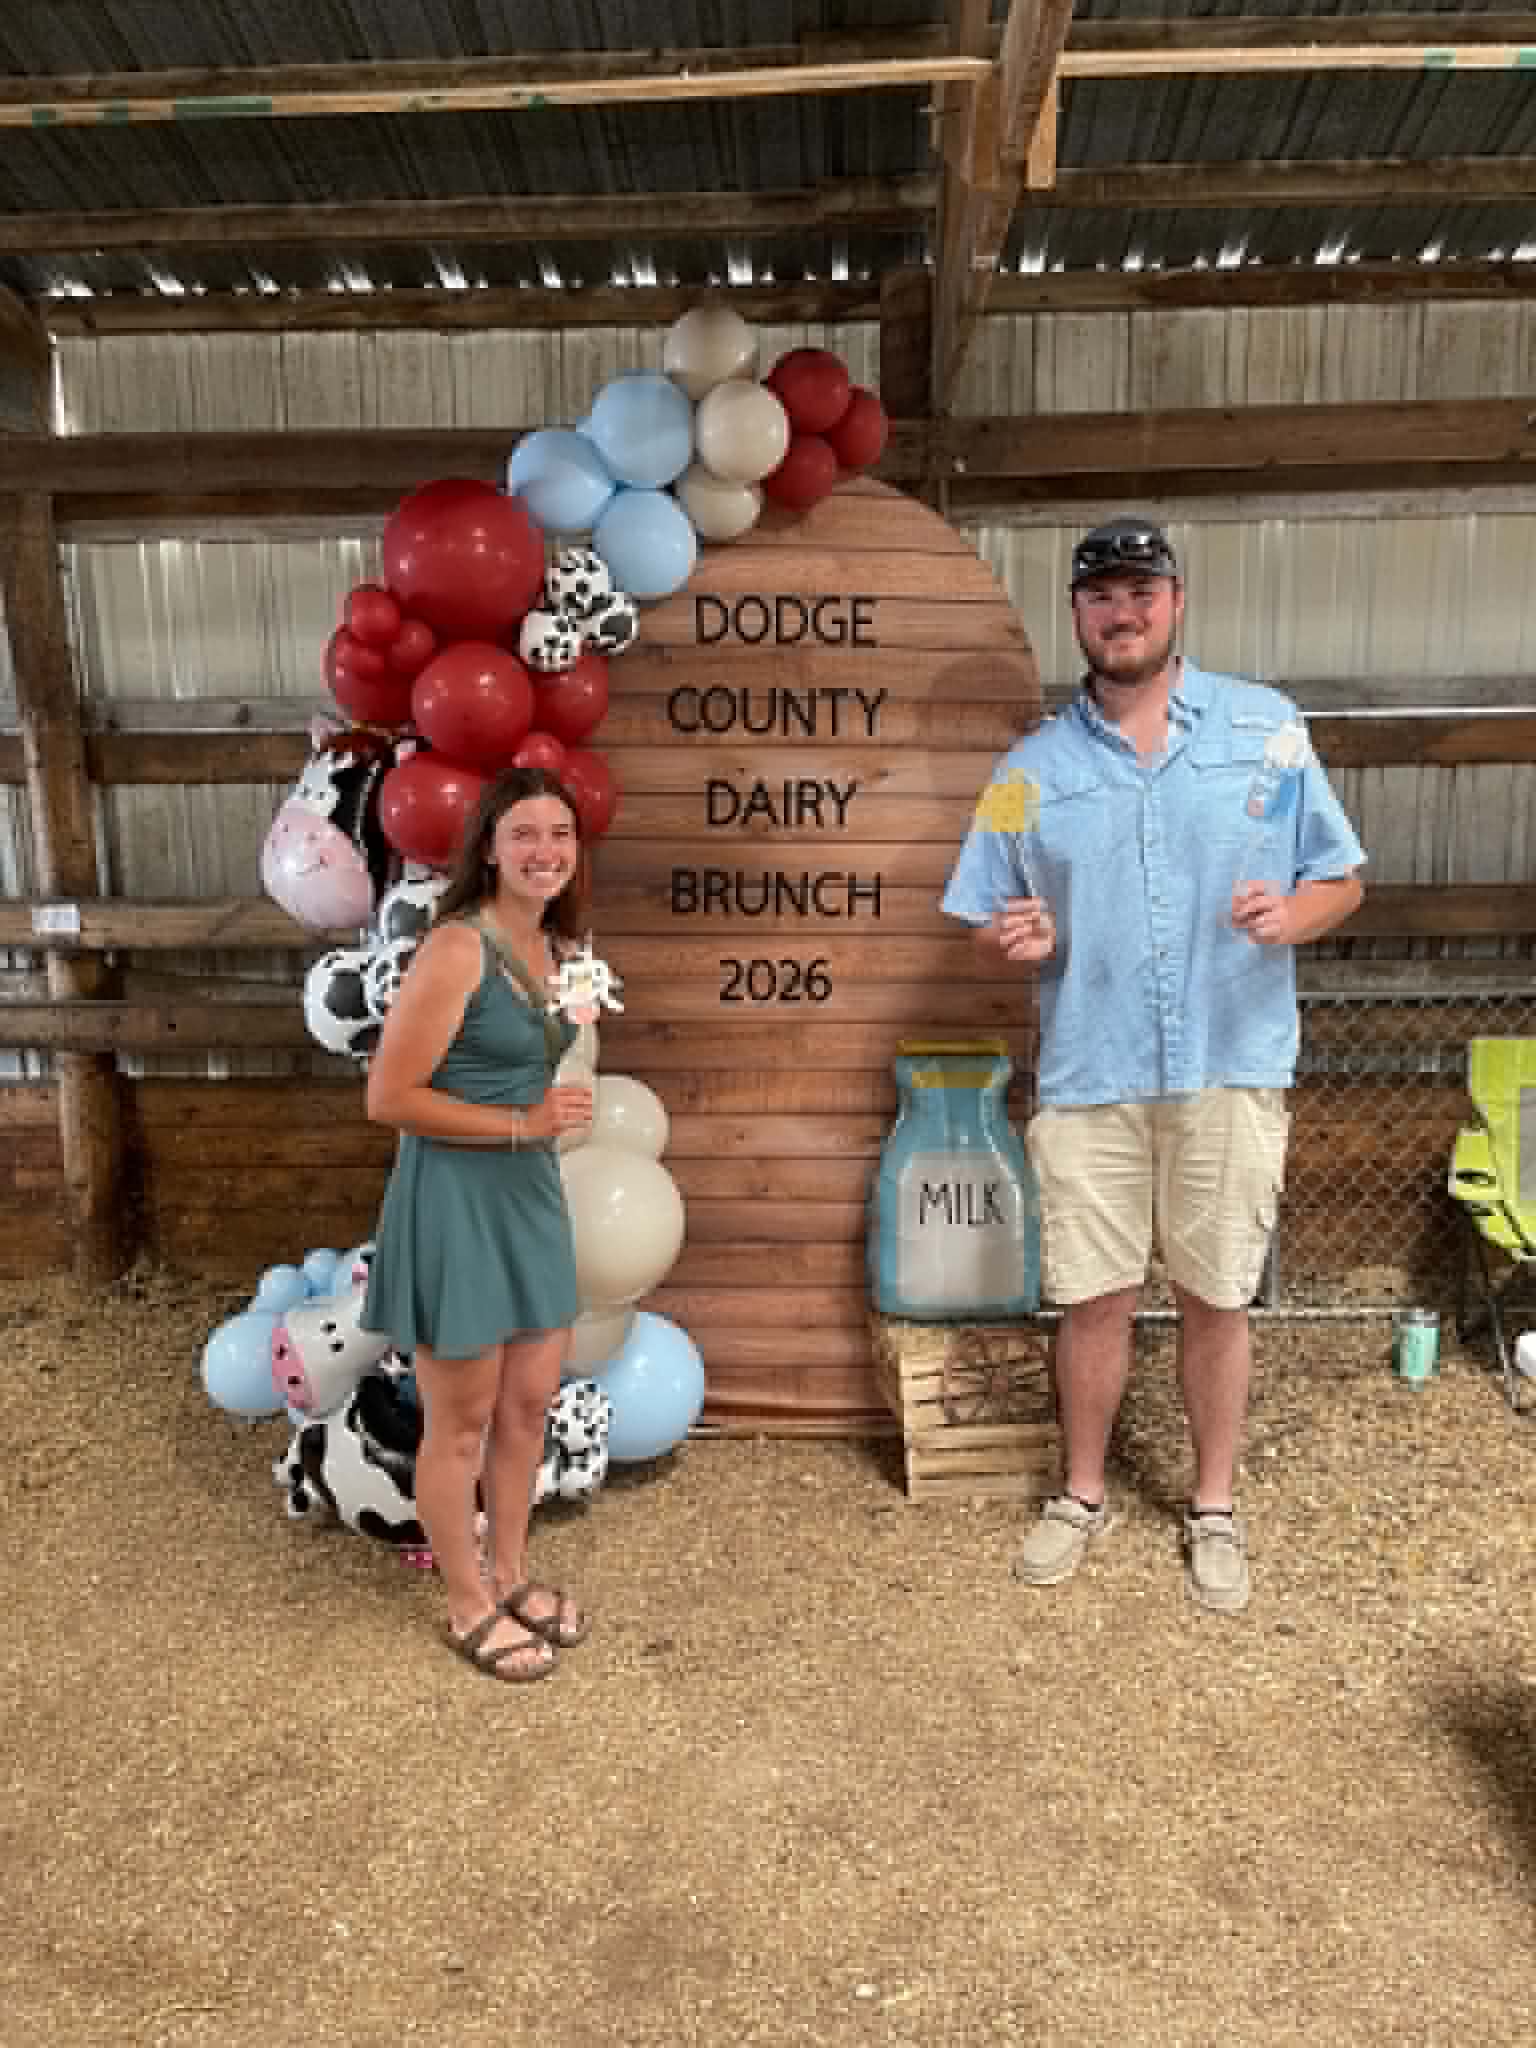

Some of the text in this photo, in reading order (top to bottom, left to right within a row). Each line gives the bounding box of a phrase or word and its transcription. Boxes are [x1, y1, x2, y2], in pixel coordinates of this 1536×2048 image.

[694, 595, 879, 646] DODGE
[667, 686, 887, 735] COUNTY
[705, 779, 858, 828] DAIRY
[671, 869, 881, 918] BRUNCH
[719, 959, 833, 1002] 2026
[919, 1182, 1007, 1225] MILK
